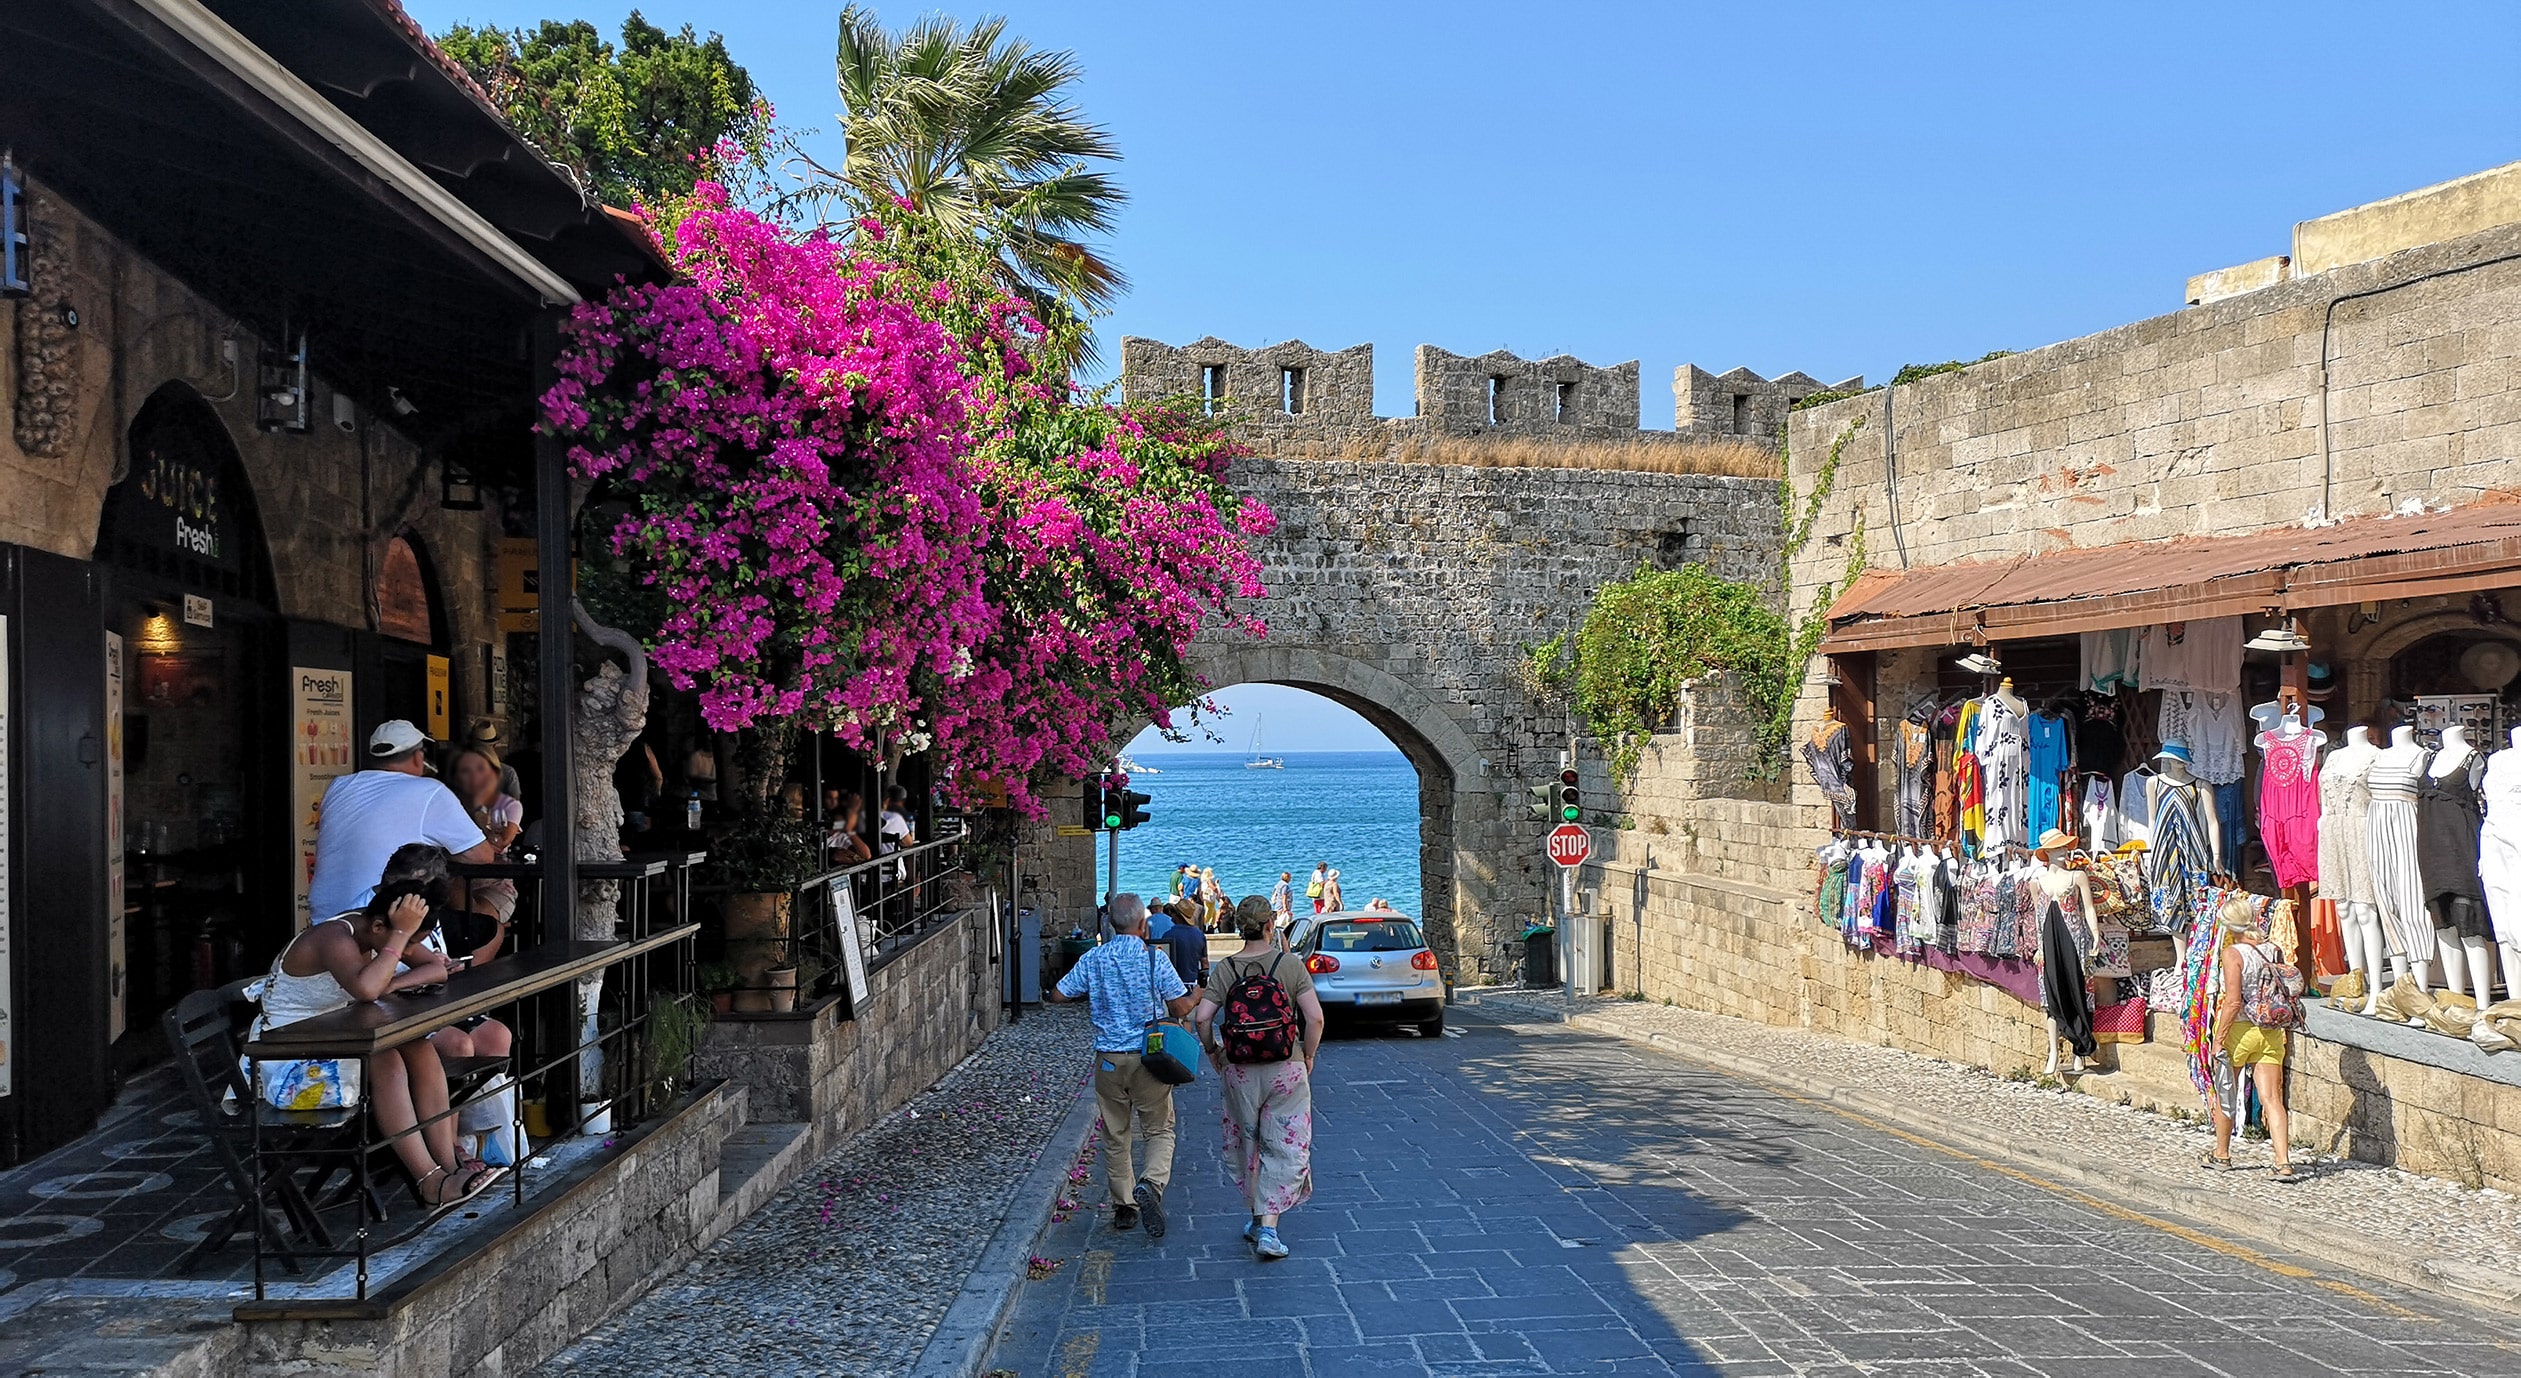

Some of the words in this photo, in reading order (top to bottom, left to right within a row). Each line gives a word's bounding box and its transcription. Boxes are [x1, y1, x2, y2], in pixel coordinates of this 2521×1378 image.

[176, 515, 214, 555] fresh
[302, 675, 339, 693] fresh
[1551, 834, 1587, 857] STOP
